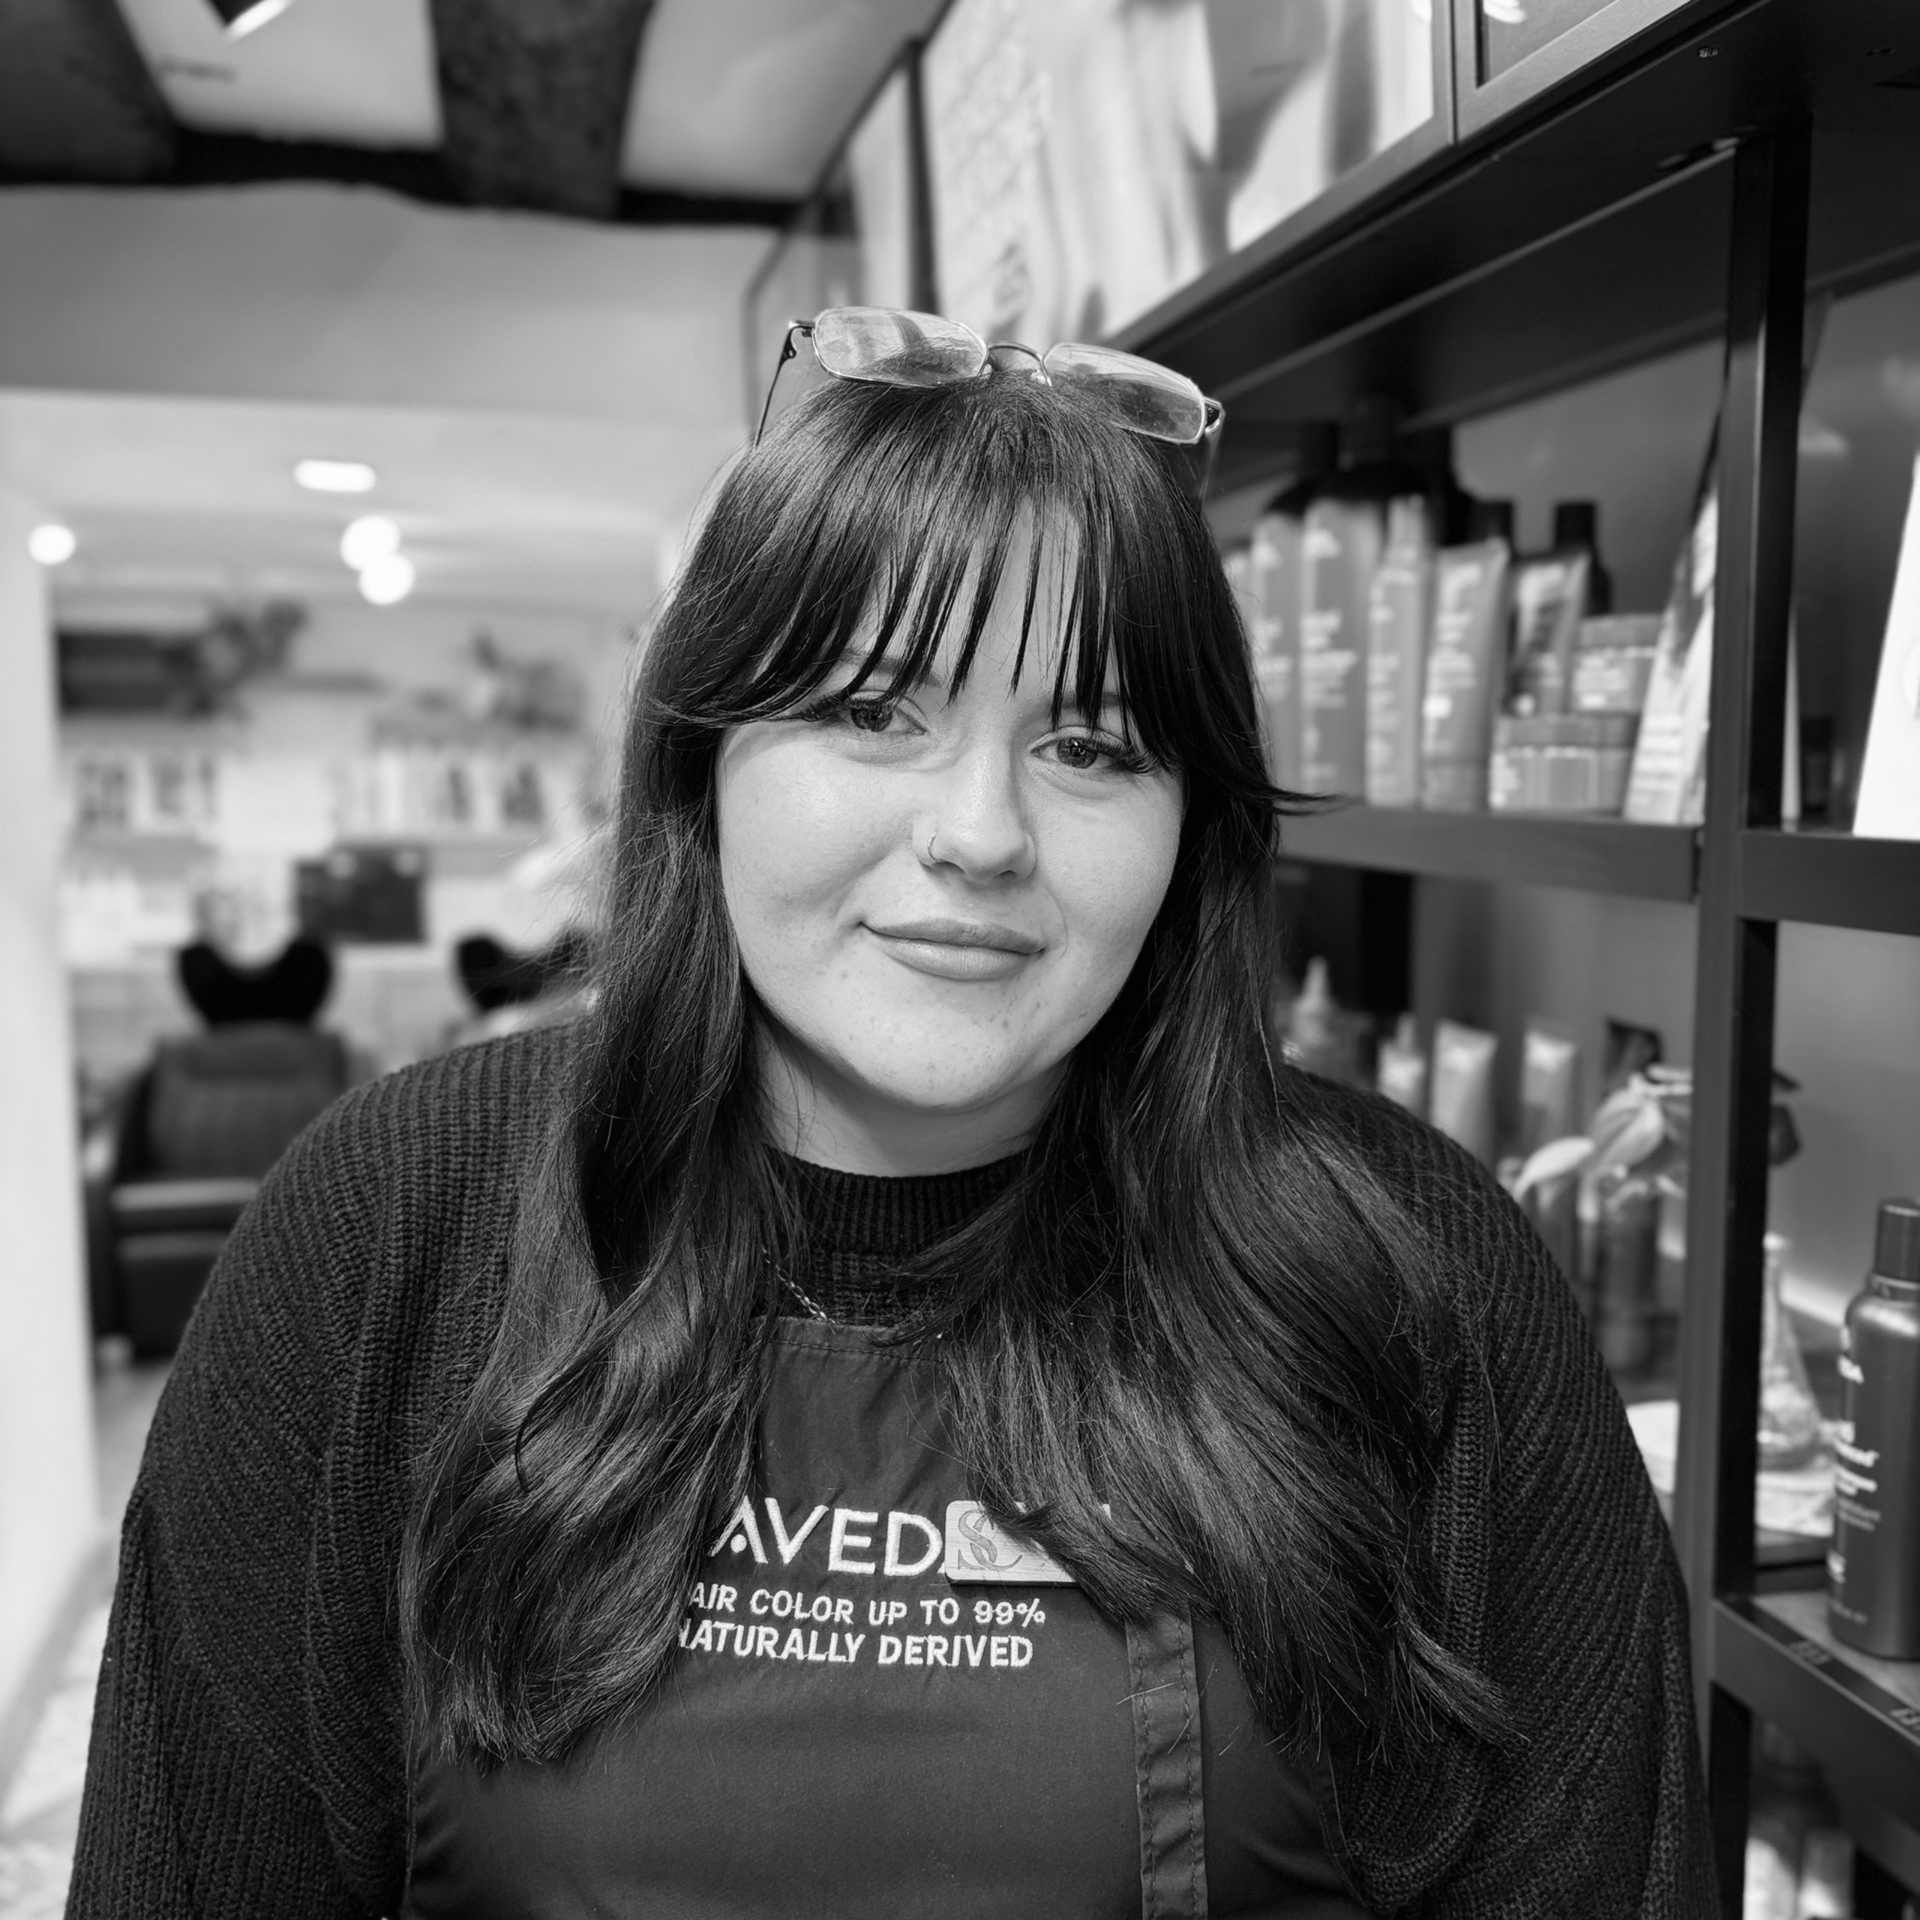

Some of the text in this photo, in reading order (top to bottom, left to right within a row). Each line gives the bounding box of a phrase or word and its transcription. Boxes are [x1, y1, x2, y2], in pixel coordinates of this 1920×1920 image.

[708, 1495, 946, 1577] AVED
[688, 1582, 1046, 1628] AIR COLOR UP TO 99%
[877, 1633, 1034, 1668] DERIVED
